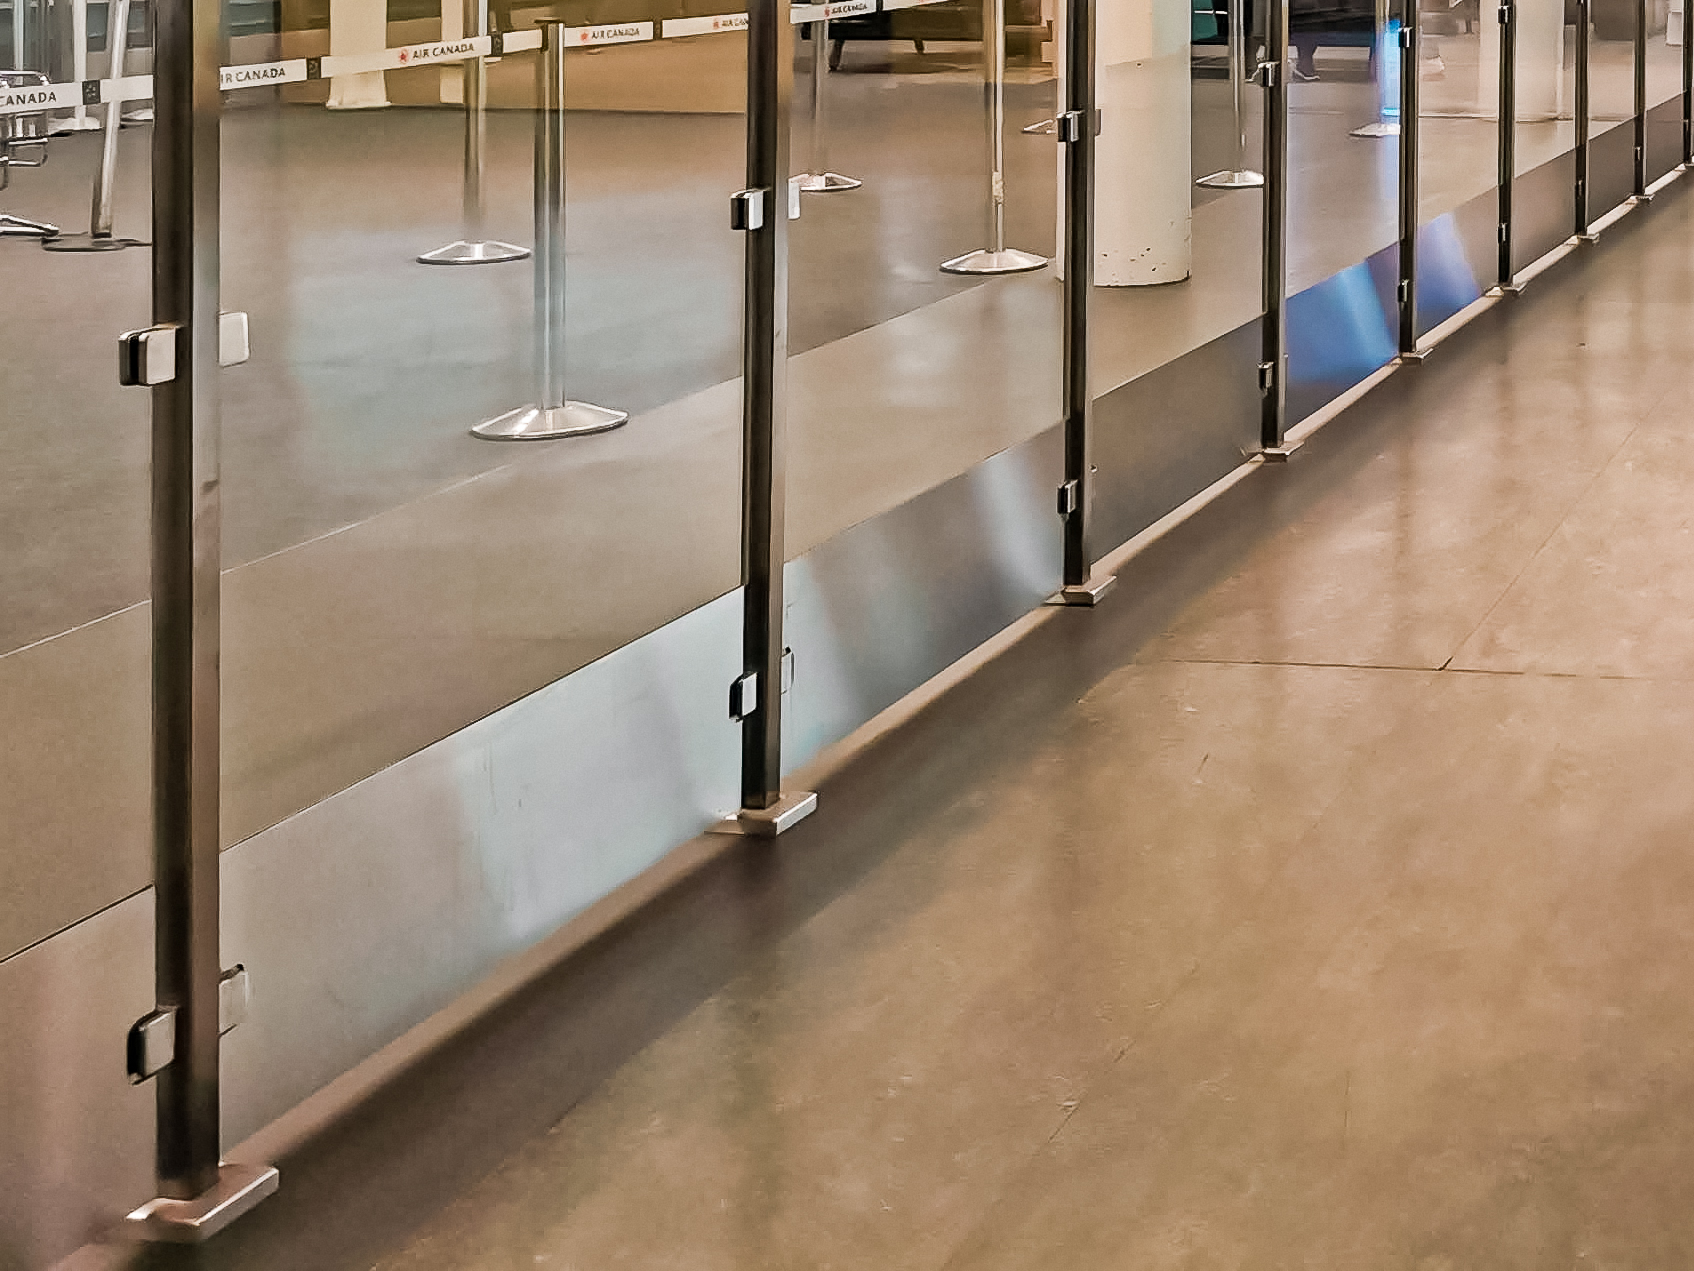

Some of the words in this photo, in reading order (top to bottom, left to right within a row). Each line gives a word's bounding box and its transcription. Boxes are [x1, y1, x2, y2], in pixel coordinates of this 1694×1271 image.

[412, 49, 430, 60] AIR
[432, 42, 475, 58] CANADA
[235, 67, 286, 83] CANADA
